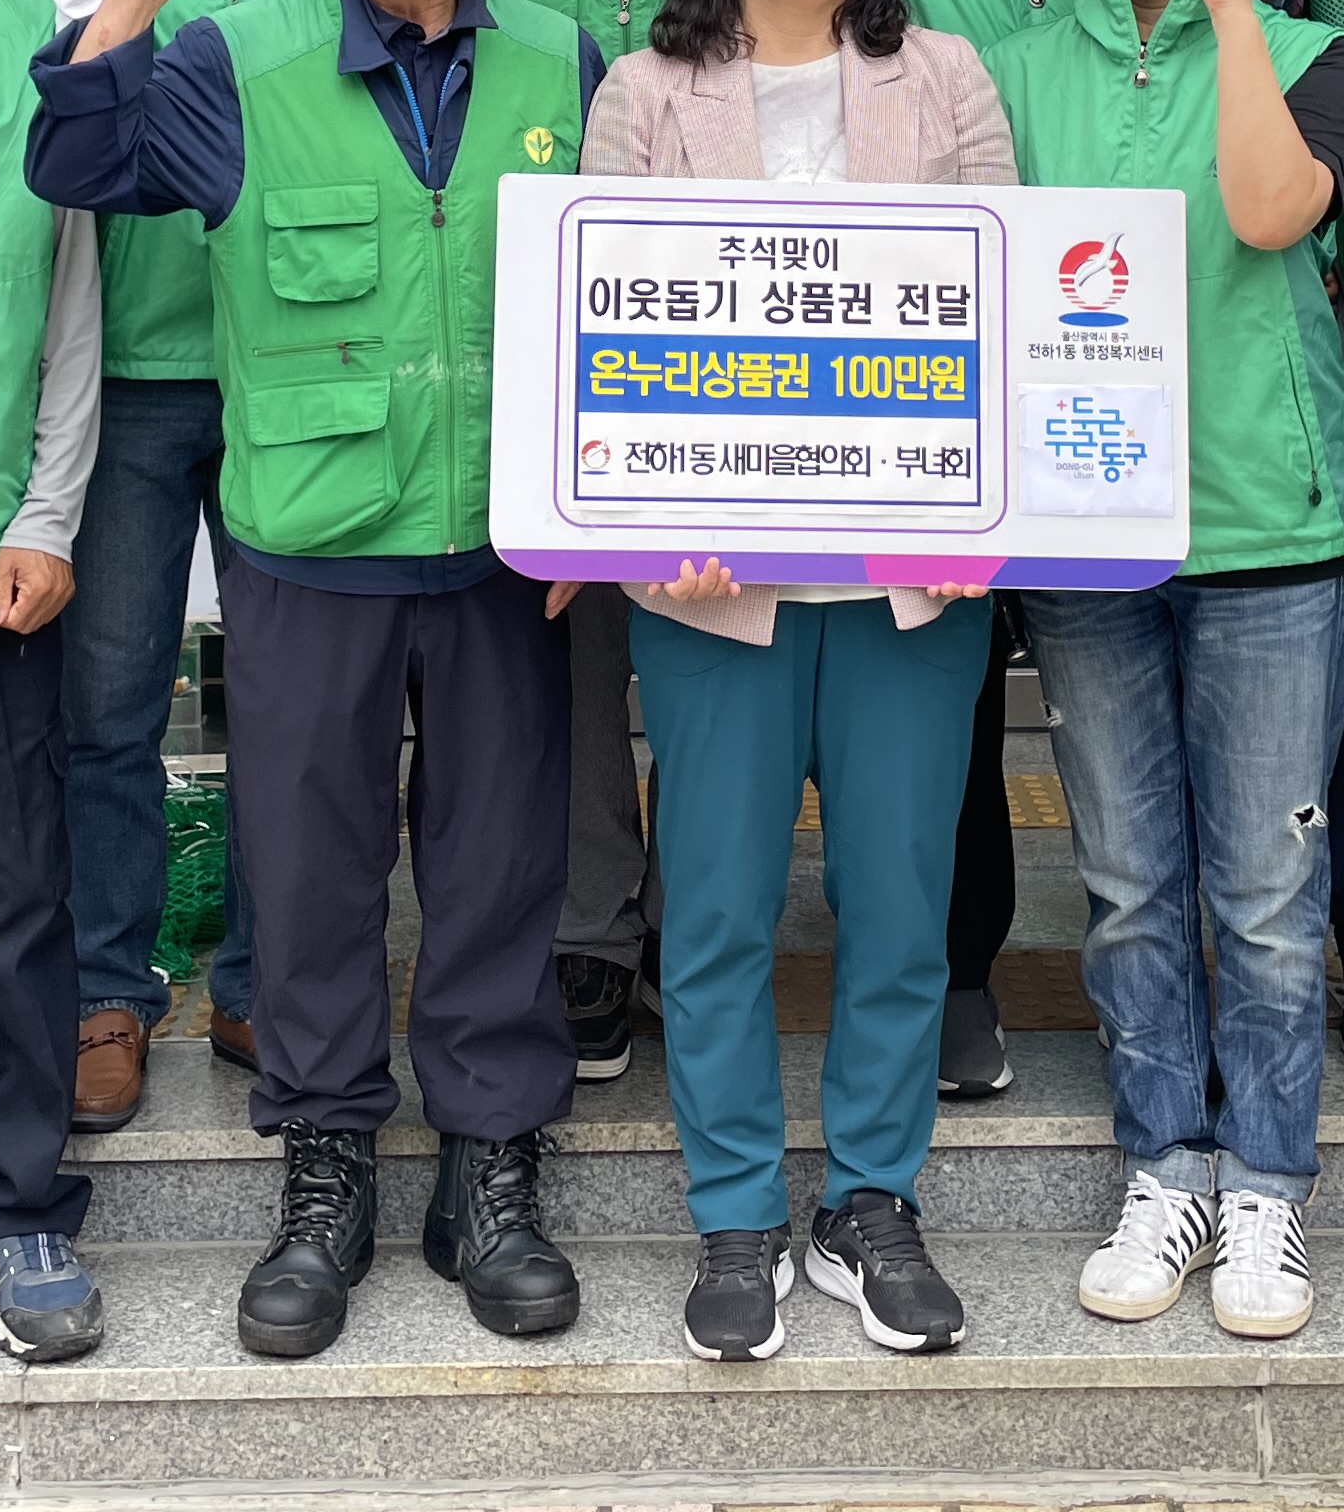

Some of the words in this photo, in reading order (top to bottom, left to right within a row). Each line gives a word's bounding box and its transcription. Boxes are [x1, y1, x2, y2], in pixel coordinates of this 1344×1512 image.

[718, 236, 839, 272] 추석맞이
[588, 277, 737, 322] 이웃돕기
[761, 281, 872, 324] 상품권
[895, 283, 971, 326] 전달
[1028, 344, 1076, 360] 전하1동
[1083, 345, 1163, 361] 행정복지센터
[589, 349, 809, 398] 온누리상품권
[830, 355, 965, 401] 100만원
[1056, 462, 1094, 471] DONG-GU
[1098, 442, 1148, 483] 동구
